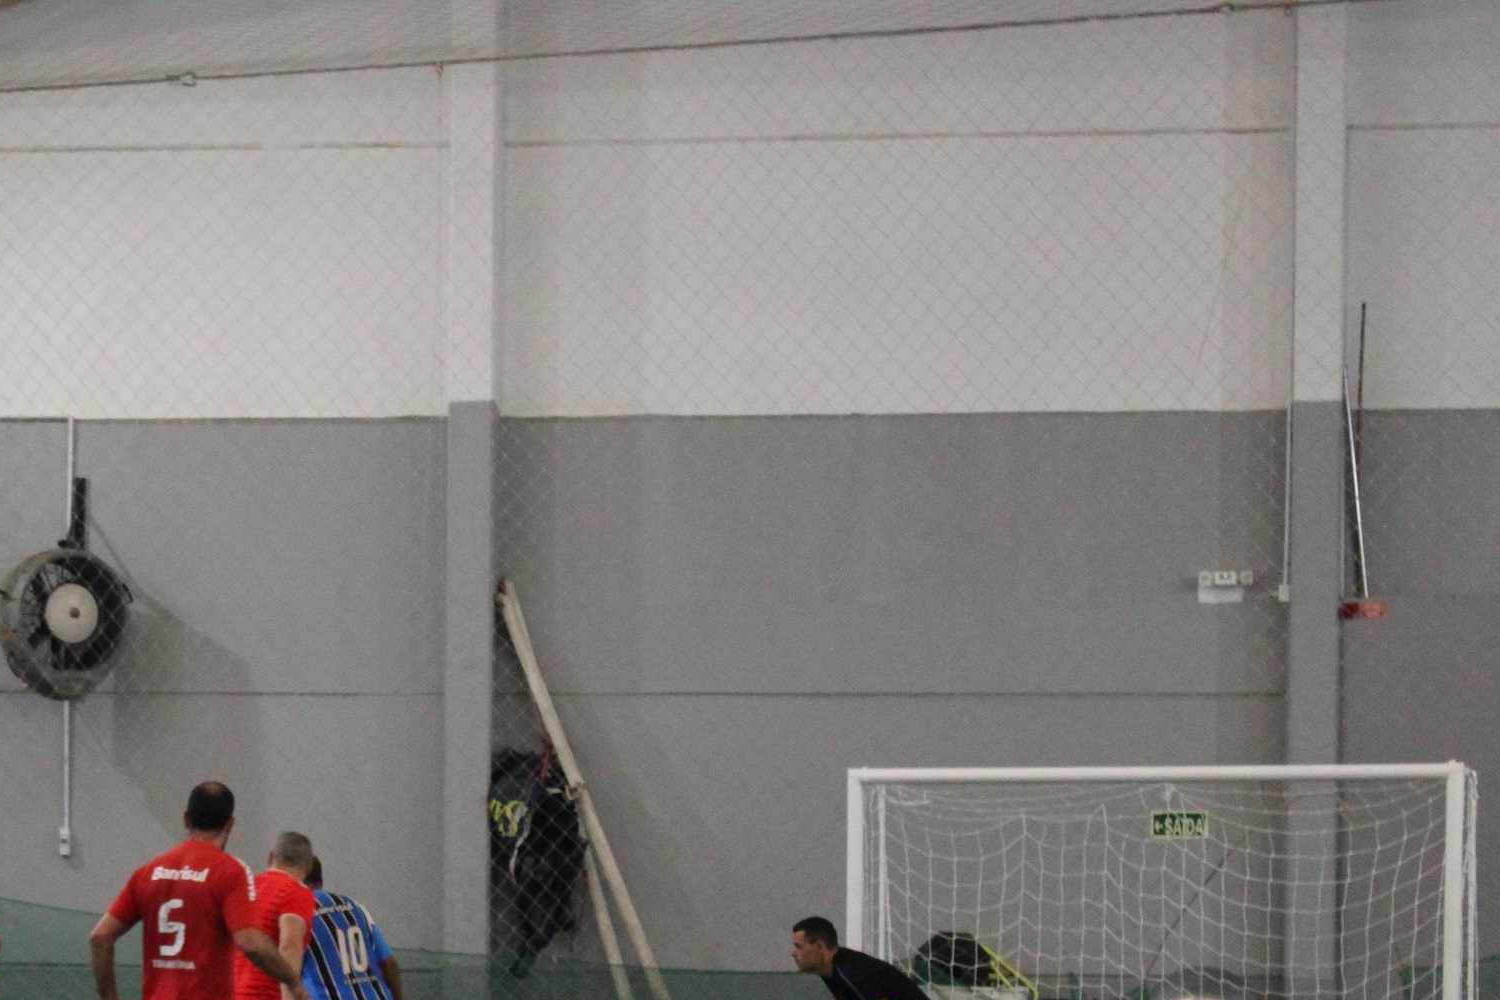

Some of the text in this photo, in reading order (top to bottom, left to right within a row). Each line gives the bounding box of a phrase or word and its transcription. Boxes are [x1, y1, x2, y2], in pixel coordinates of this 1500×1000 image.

[151, 865, 210, 882] Banrisul
[158, 898, 186, 956] 5
[336, 926, 369, 976] 10
